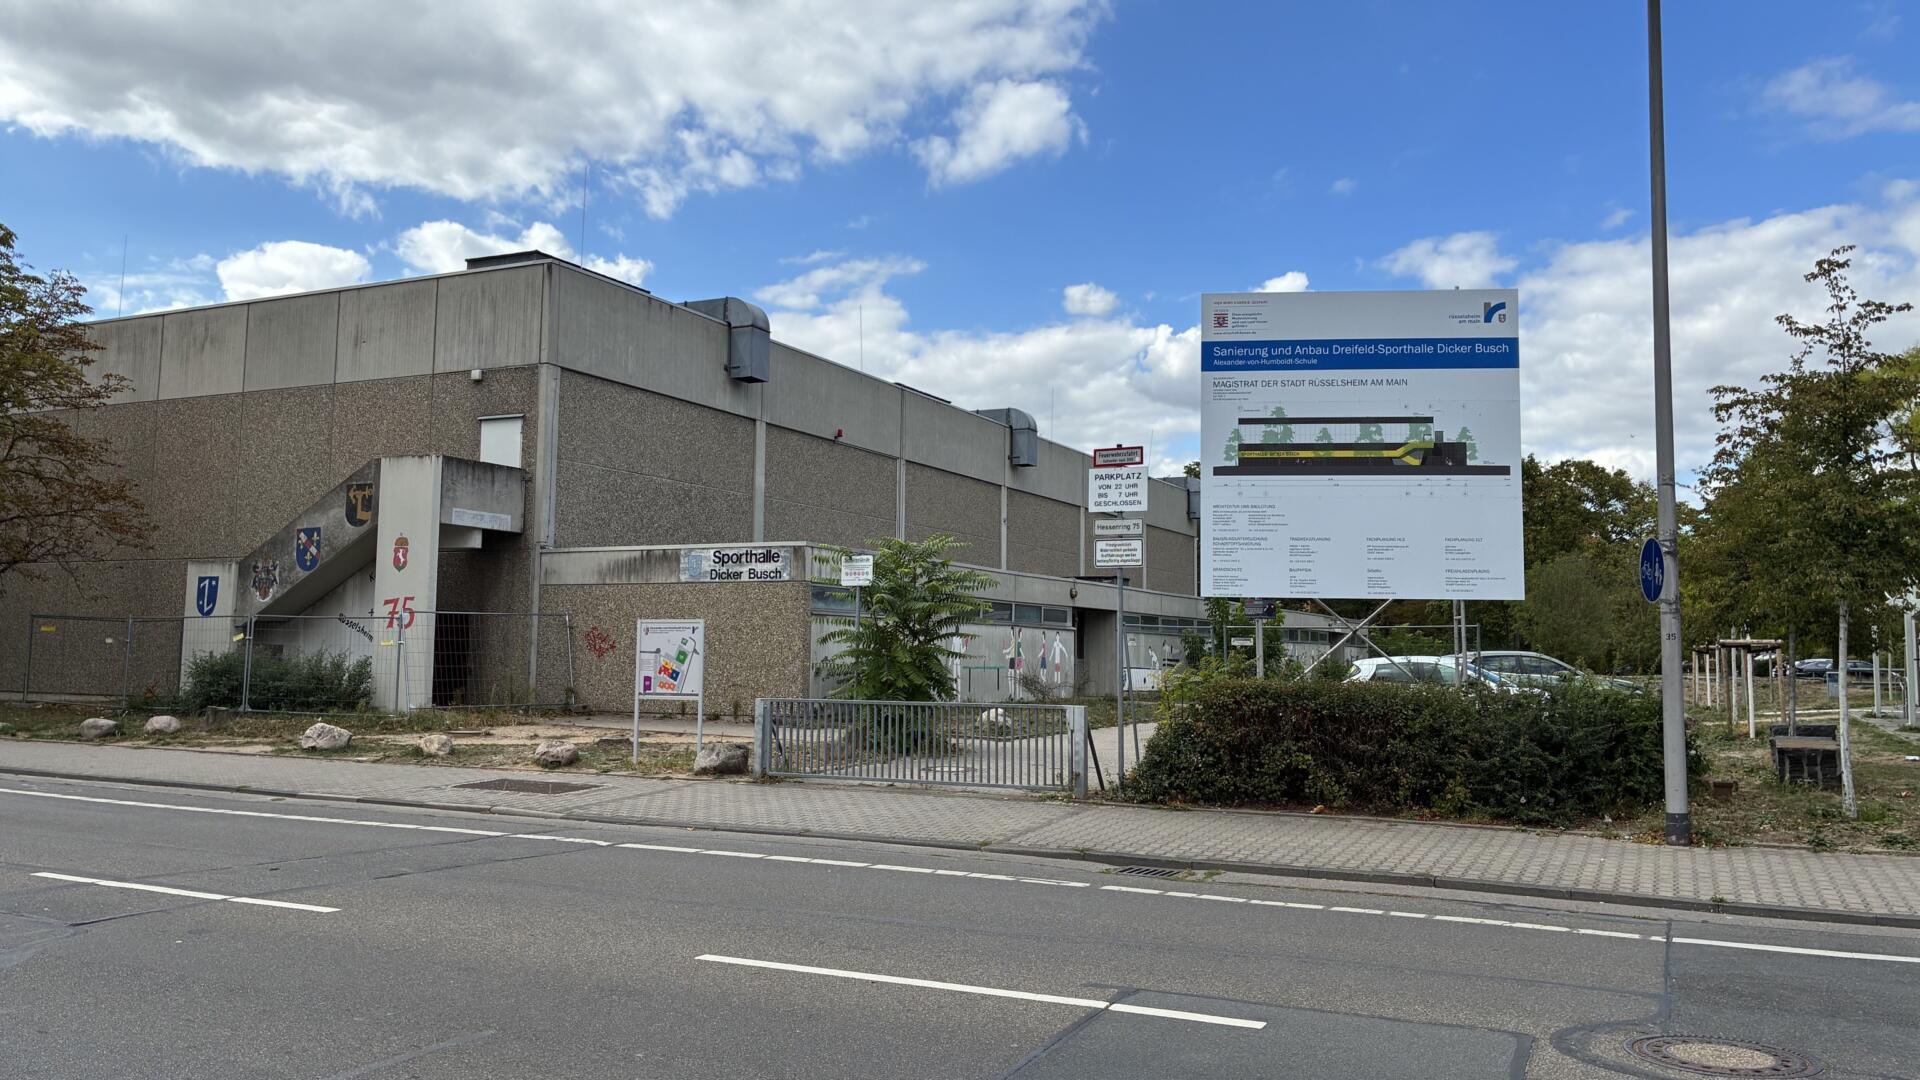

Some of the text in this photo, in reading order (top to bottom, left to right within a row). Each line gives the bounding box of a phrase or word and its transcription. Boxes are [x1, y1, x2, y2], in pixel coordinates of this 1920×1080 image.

[1213, 343, 1509, 358] Sanierung und Anbau Dreifeld-Sporthalle Dicker Busch
[1213, 358, 1318, 366] Alexander-von-Humboldt-Schule
[1213, 377, 1408, 388] MAGISTRAT DER STADT RÜSSELSHEIM AM MAIN
[1094, 472, 1142, 480] PARKPLATZ
[1097, 523, 1131, 531] Hessenring
[712, 550, 780, 567] Sporthalle
[710, 568, 782, 580] Dicker Busch
[382, 596, 416, 630] 75
[338, 612, 374, 643] Rüsselsheim
[1665, 633, 1677, 641] 35
